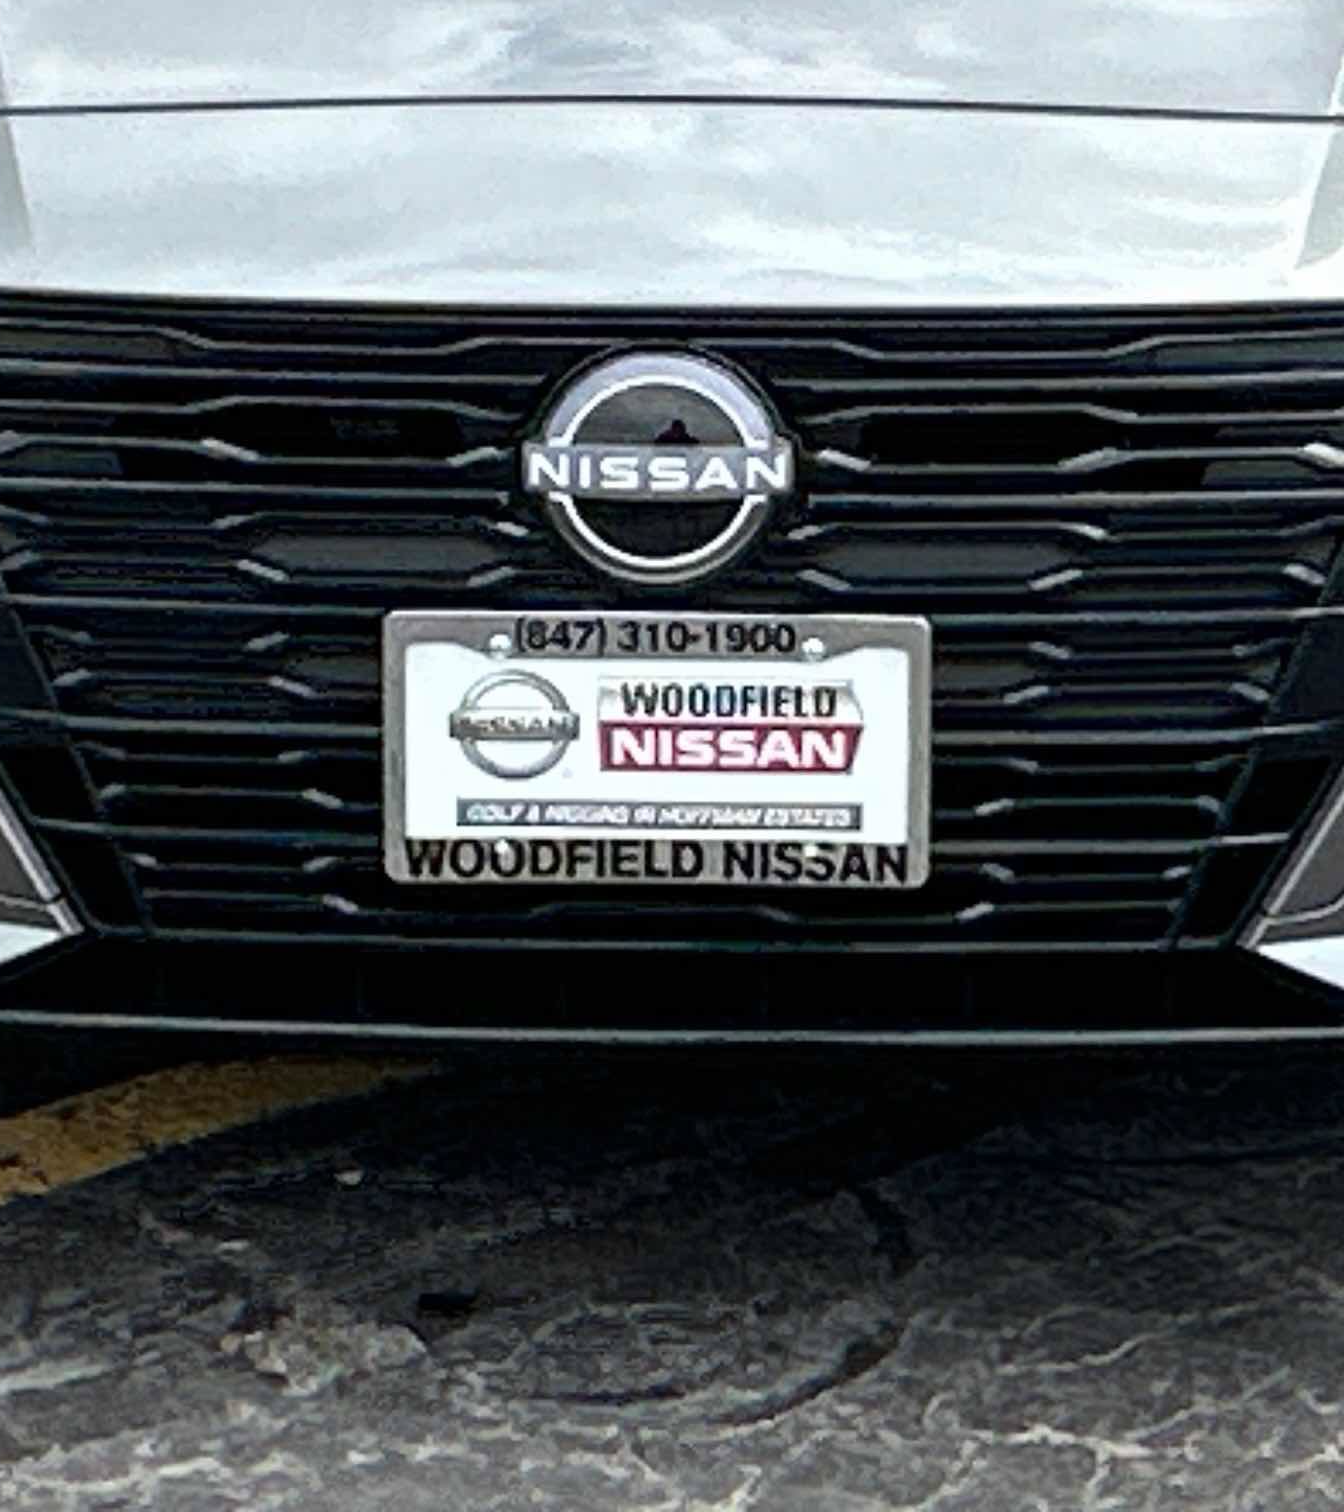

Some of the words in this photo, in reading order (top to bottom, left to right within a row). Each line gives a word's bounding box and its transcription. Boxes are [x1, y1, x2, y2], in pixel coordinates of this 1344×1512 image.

[529, 452, 786, 491] NISSAN
[515, 617, 605, 656] (847)
[617, 620, 796, 653] 310-1900
[621, 682, 838, 717] WOODFIELD
[611, 727, 847, 769] NISSAN
[404, 838, 704, 878] WOODFIELD
[722, 841, 908, 883] NISSAN
